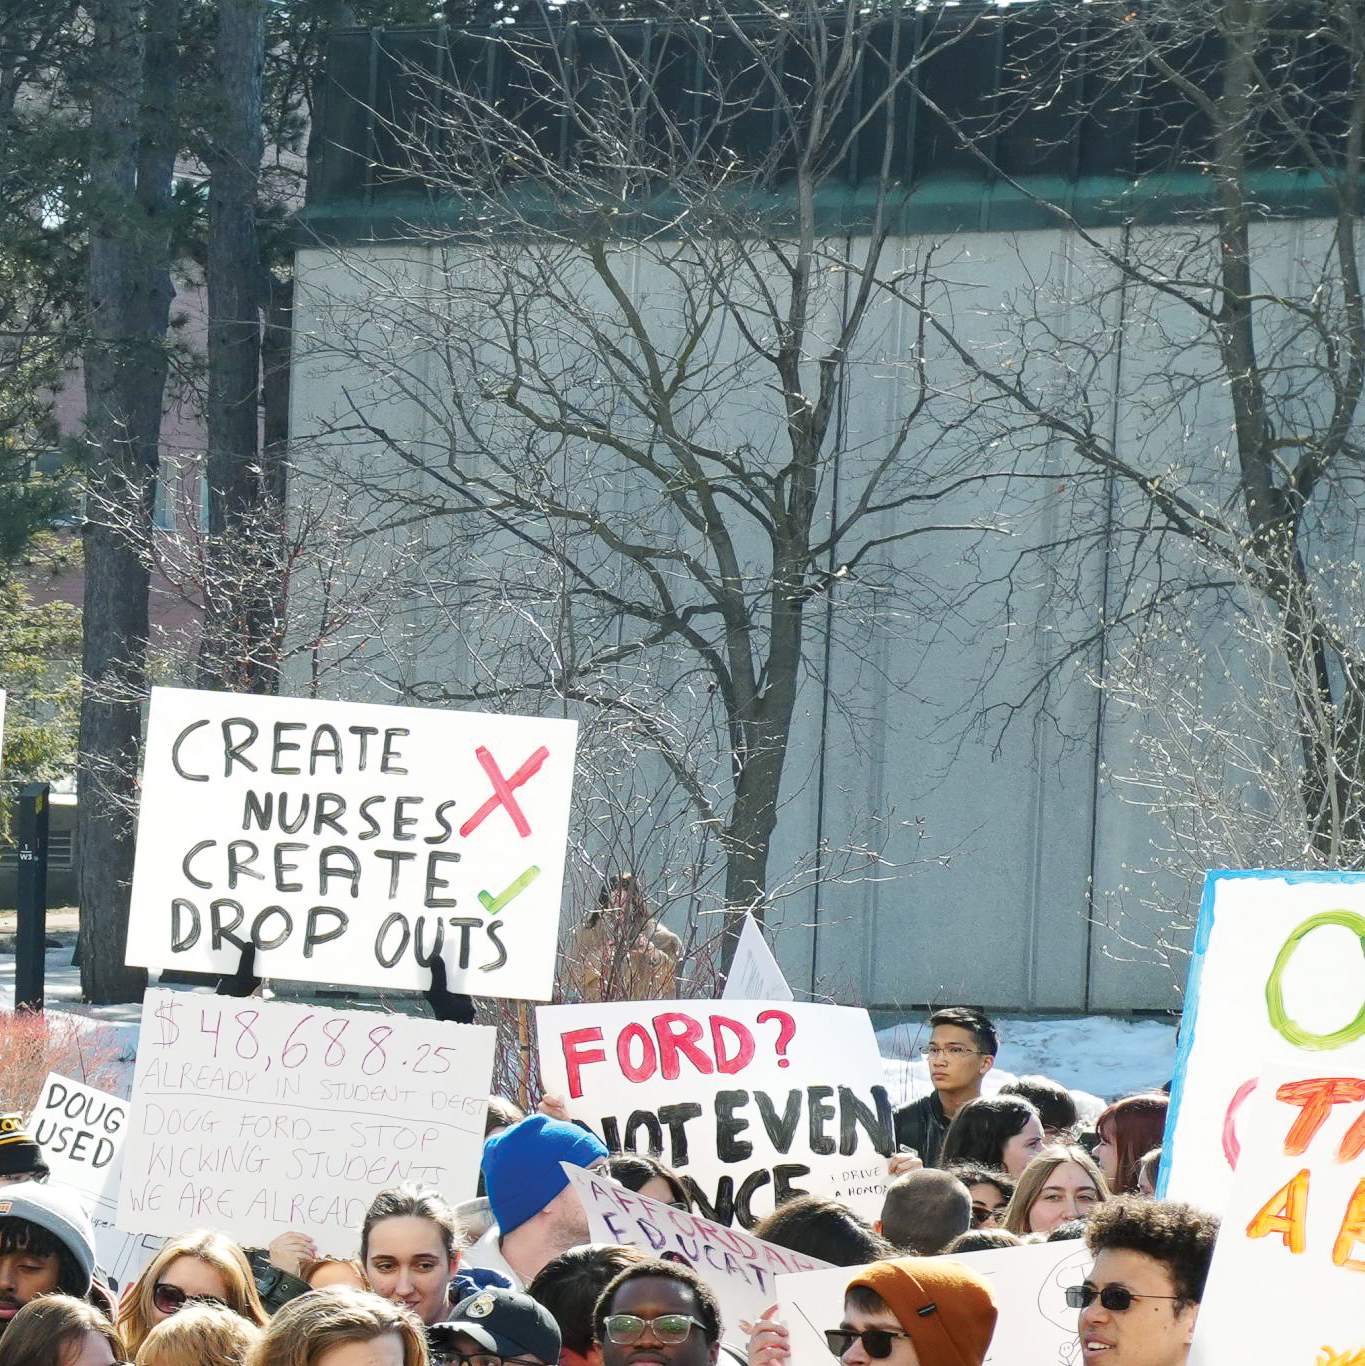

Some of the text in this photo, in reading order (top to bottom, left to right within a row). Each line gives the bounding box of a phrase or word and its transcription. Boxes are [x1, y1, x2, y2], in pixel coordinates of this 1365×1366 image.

[172, 716, 411, 782] CREATE
[242, 789, 458, 844] NURSES
[182, 839, 462, 908] CREATE
[170, 897, 509, 973] DROP OUTS
[561, 1009, 796, 1099] FORD?
[45, 1082, 126, 1134] DOUG
[139, 1057, 491, 1116] ALREADY IN STUDENT DEBT
[34, 1118, 116, 1168] USED
[143, 1103, 221, 1137] DOUG
[350, 1121, 440, 1152] STOP
[714, 1085, 896, 1164] EVEN
[147, 1141, 271, 1179] KICKING
[842, 1166, 881, 1182] DRIVE
[129, 1179, 166, 1213] WE
[178, 1181, 234, 1220] ARE
